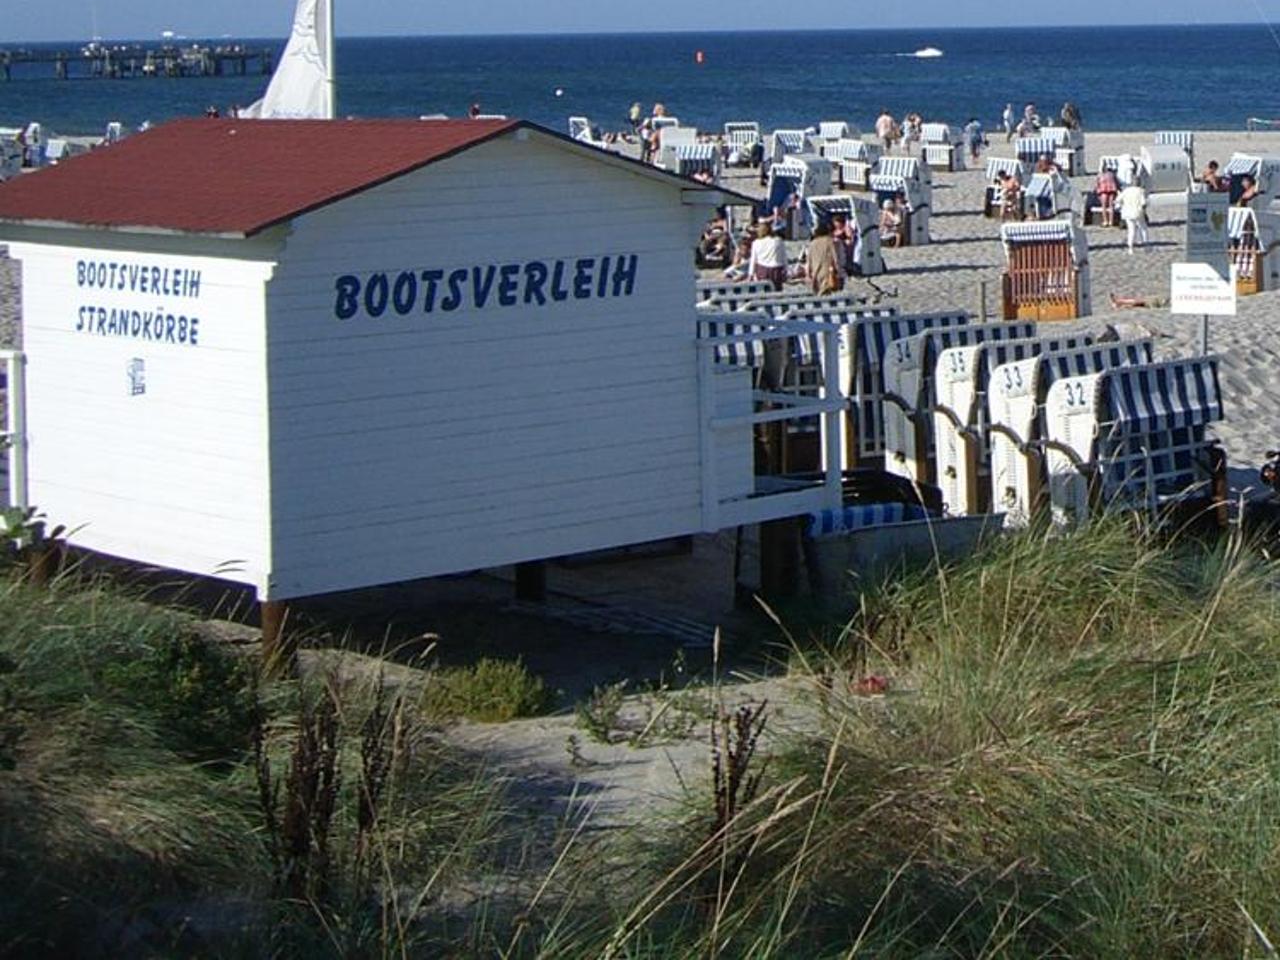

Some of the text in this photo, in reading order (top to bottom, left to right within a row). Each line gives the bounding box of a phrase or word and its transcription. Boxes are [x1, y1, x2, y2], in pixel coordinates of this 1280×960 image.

[77, 260, 201, 298] BOOTSVERLEIH
[335, 254, 638, 320] BOOTSVERLEIH
[76, 305, 199, 344] STRANDKÖRBE
[1003, 366, 1024, 390] 33
[1064, 382, 1087, 407] 32
